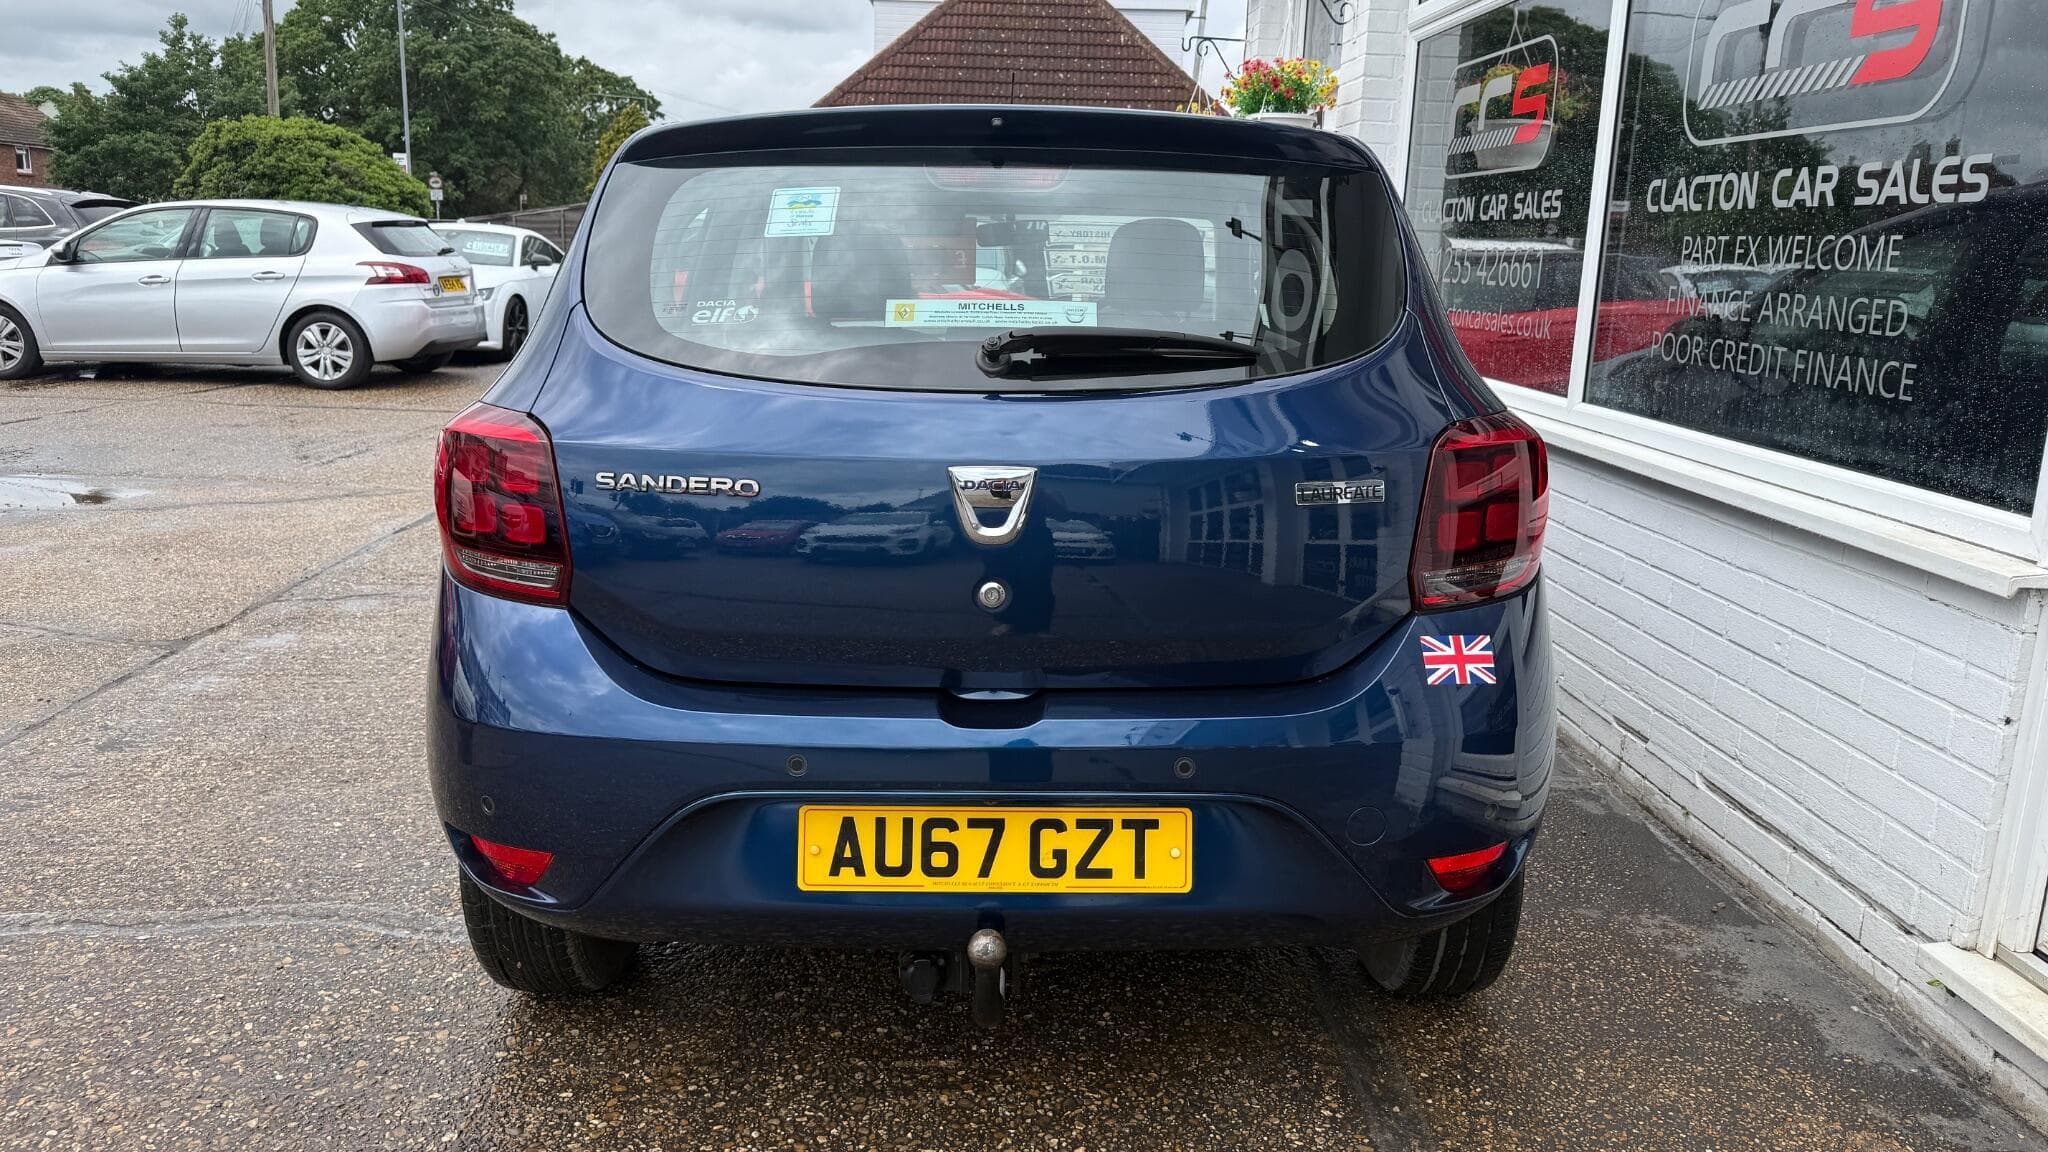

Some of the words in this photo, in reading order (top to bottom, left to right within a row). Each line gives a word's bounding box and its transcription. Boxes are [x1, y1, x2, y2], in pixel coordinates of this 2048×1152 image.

[1646, 170, 1759, 213] CLACTON
[1771, 165, 1839, 208] CAR
[1854, 153, 1993, 206] SALES
[1422, 196, 1475, 224] CLACTON
[1480, 194, 1508, 221] CAR
[1512, 189, 1563, 220] SALES
[1477, 247, 1544, 289] 426661
[1681, 235, 1729, 266] PART
[1734, 235, 1762, 269] EX
[1768, 234, 1903, 273] WELCOME
[958, 302, 1025, 311] MITCHELLS
[1447, 304, 1552, 340] ctoncarsales.co.uk
[1666, 285, 1754, 322] FINANCE
[1757, 292, 1908, 337] ARRANGED
[1650, 331, 1704, 367] POOR
[1709, 338, 1788, 380] CREDIT
[1792, 349, 1918, 401] FINANCE
[595, 471, 761, 497] SANDERO
[963, 480, 1021, 491] DACIA
[1300, 484, 1384, 502] LAUREATE
[828, 815, 1006, 879] AU67
[1028, 817, 1160, 880] GZT
